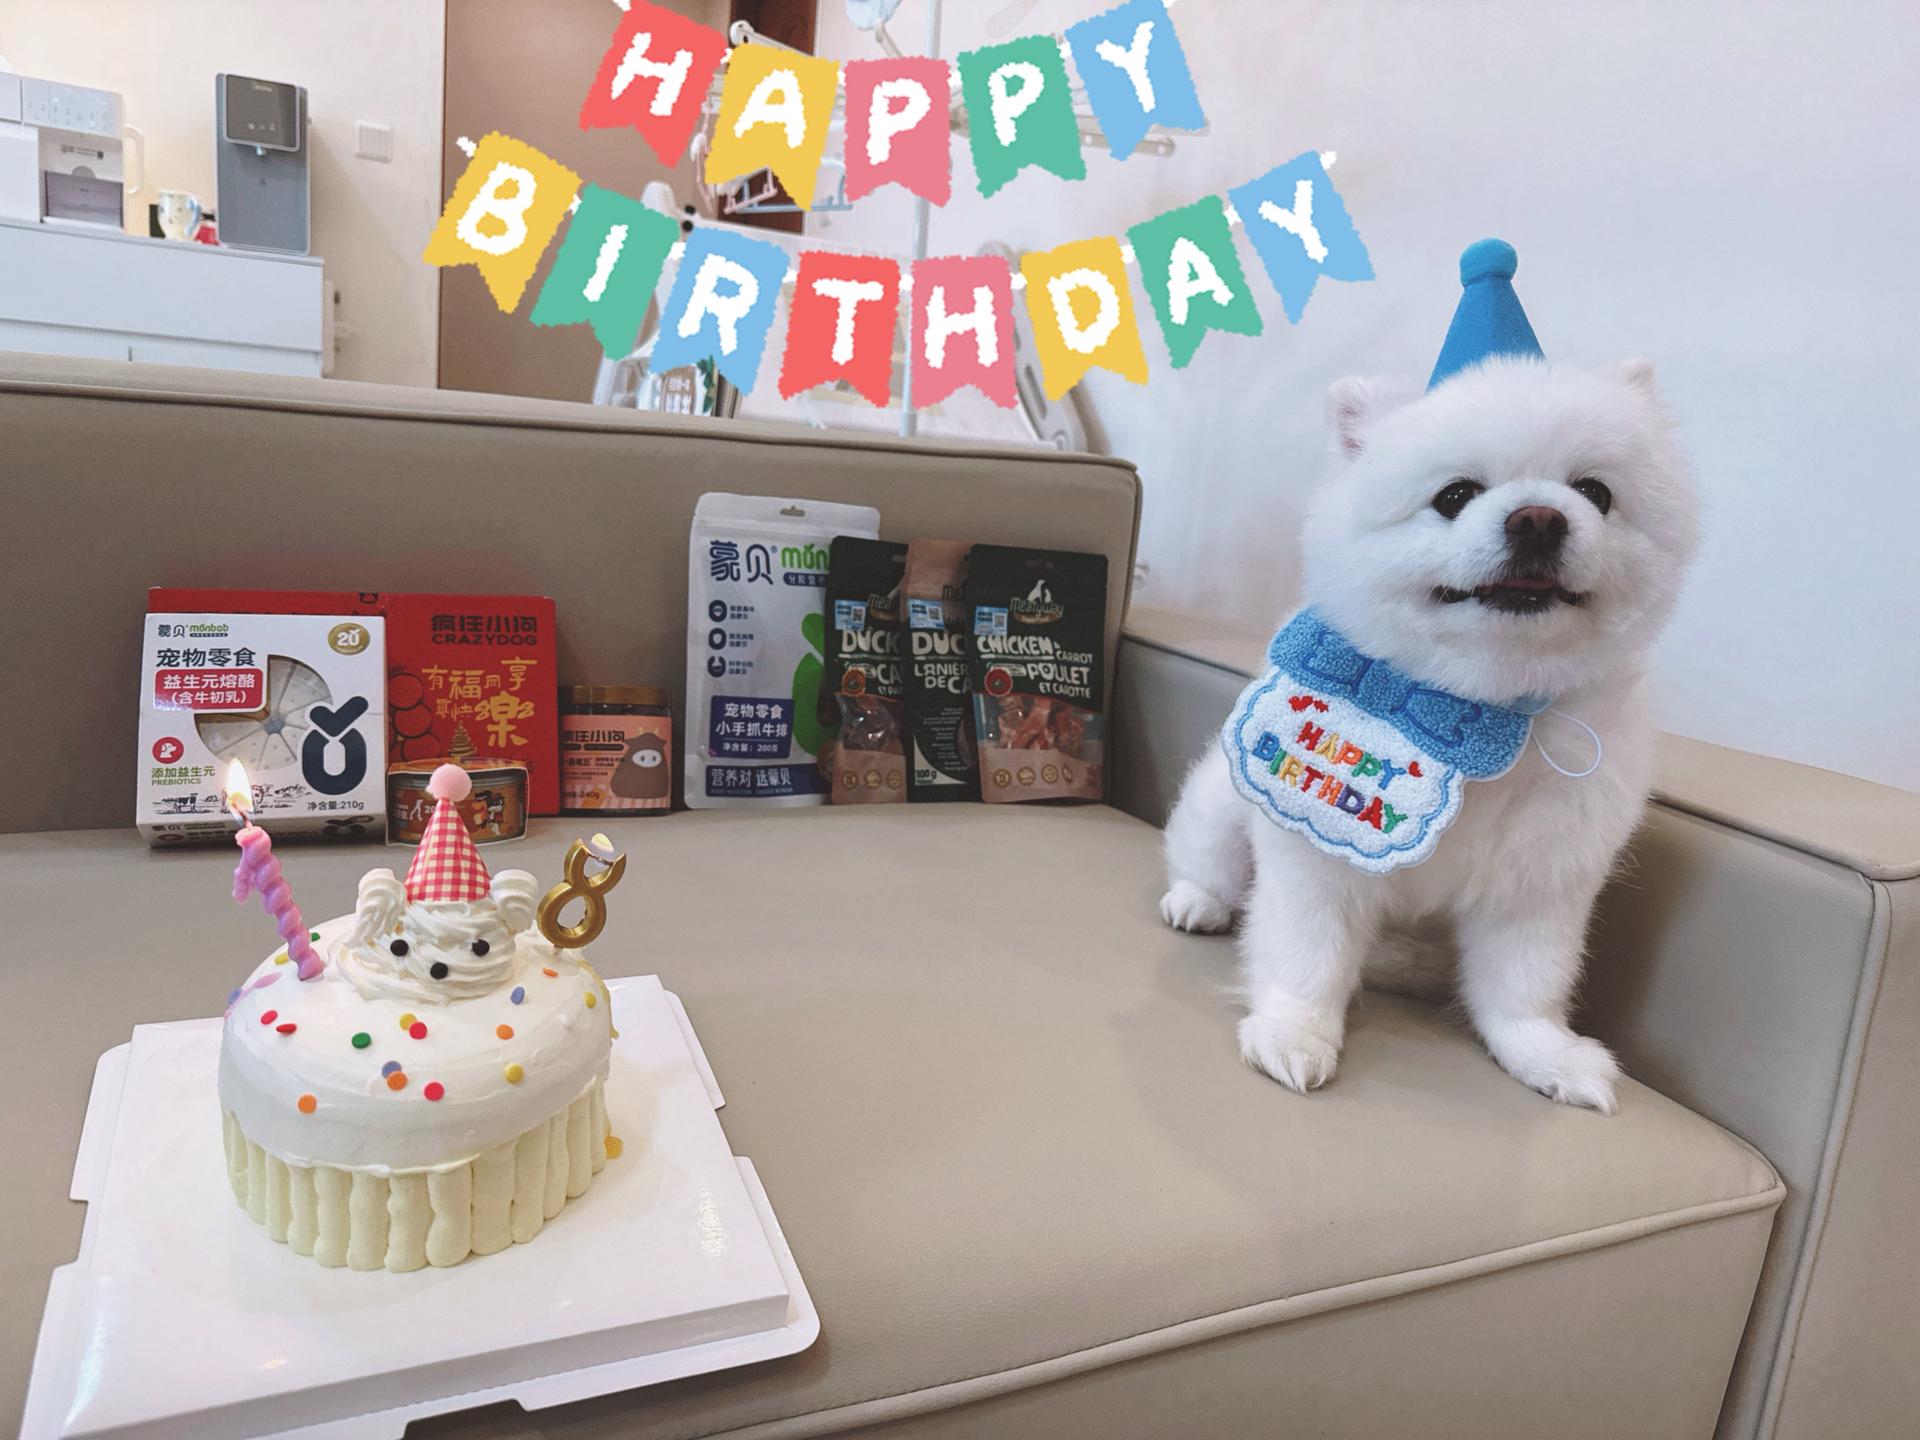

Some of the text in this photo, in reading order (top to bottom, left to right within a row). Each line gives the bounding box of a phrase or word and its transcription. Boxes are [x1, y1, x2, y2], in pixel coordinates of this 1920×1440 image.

[431, 634, 537, 646] CRAZYDOG
[156, 647, 256, 667] 宠物零食
[977, 635, 1053, 655] CHICKEN
[1056, 650, 1093, 663] CARROT
[163, 673, 256, 689] 益生元熔酪
[1026, 662, 1091, 685] POULET
[924, 676, 946, 689] DE
[1039, 682, 1091, 698] ET CAROTTE
[724, 703, 784, 720] 宠物零食
[715, 721, 788, 738] 小手抓牛排
[1296, 721, 1407, 790] HAPPY
[151, 765, 215, 778] 添加益生元
[711, 767, 792, 787] 营养对 选蒙贝
[151, 778, 202, 786] PREBIOTICS
[1252, 732, 1408, 833] BIRTHDAY
